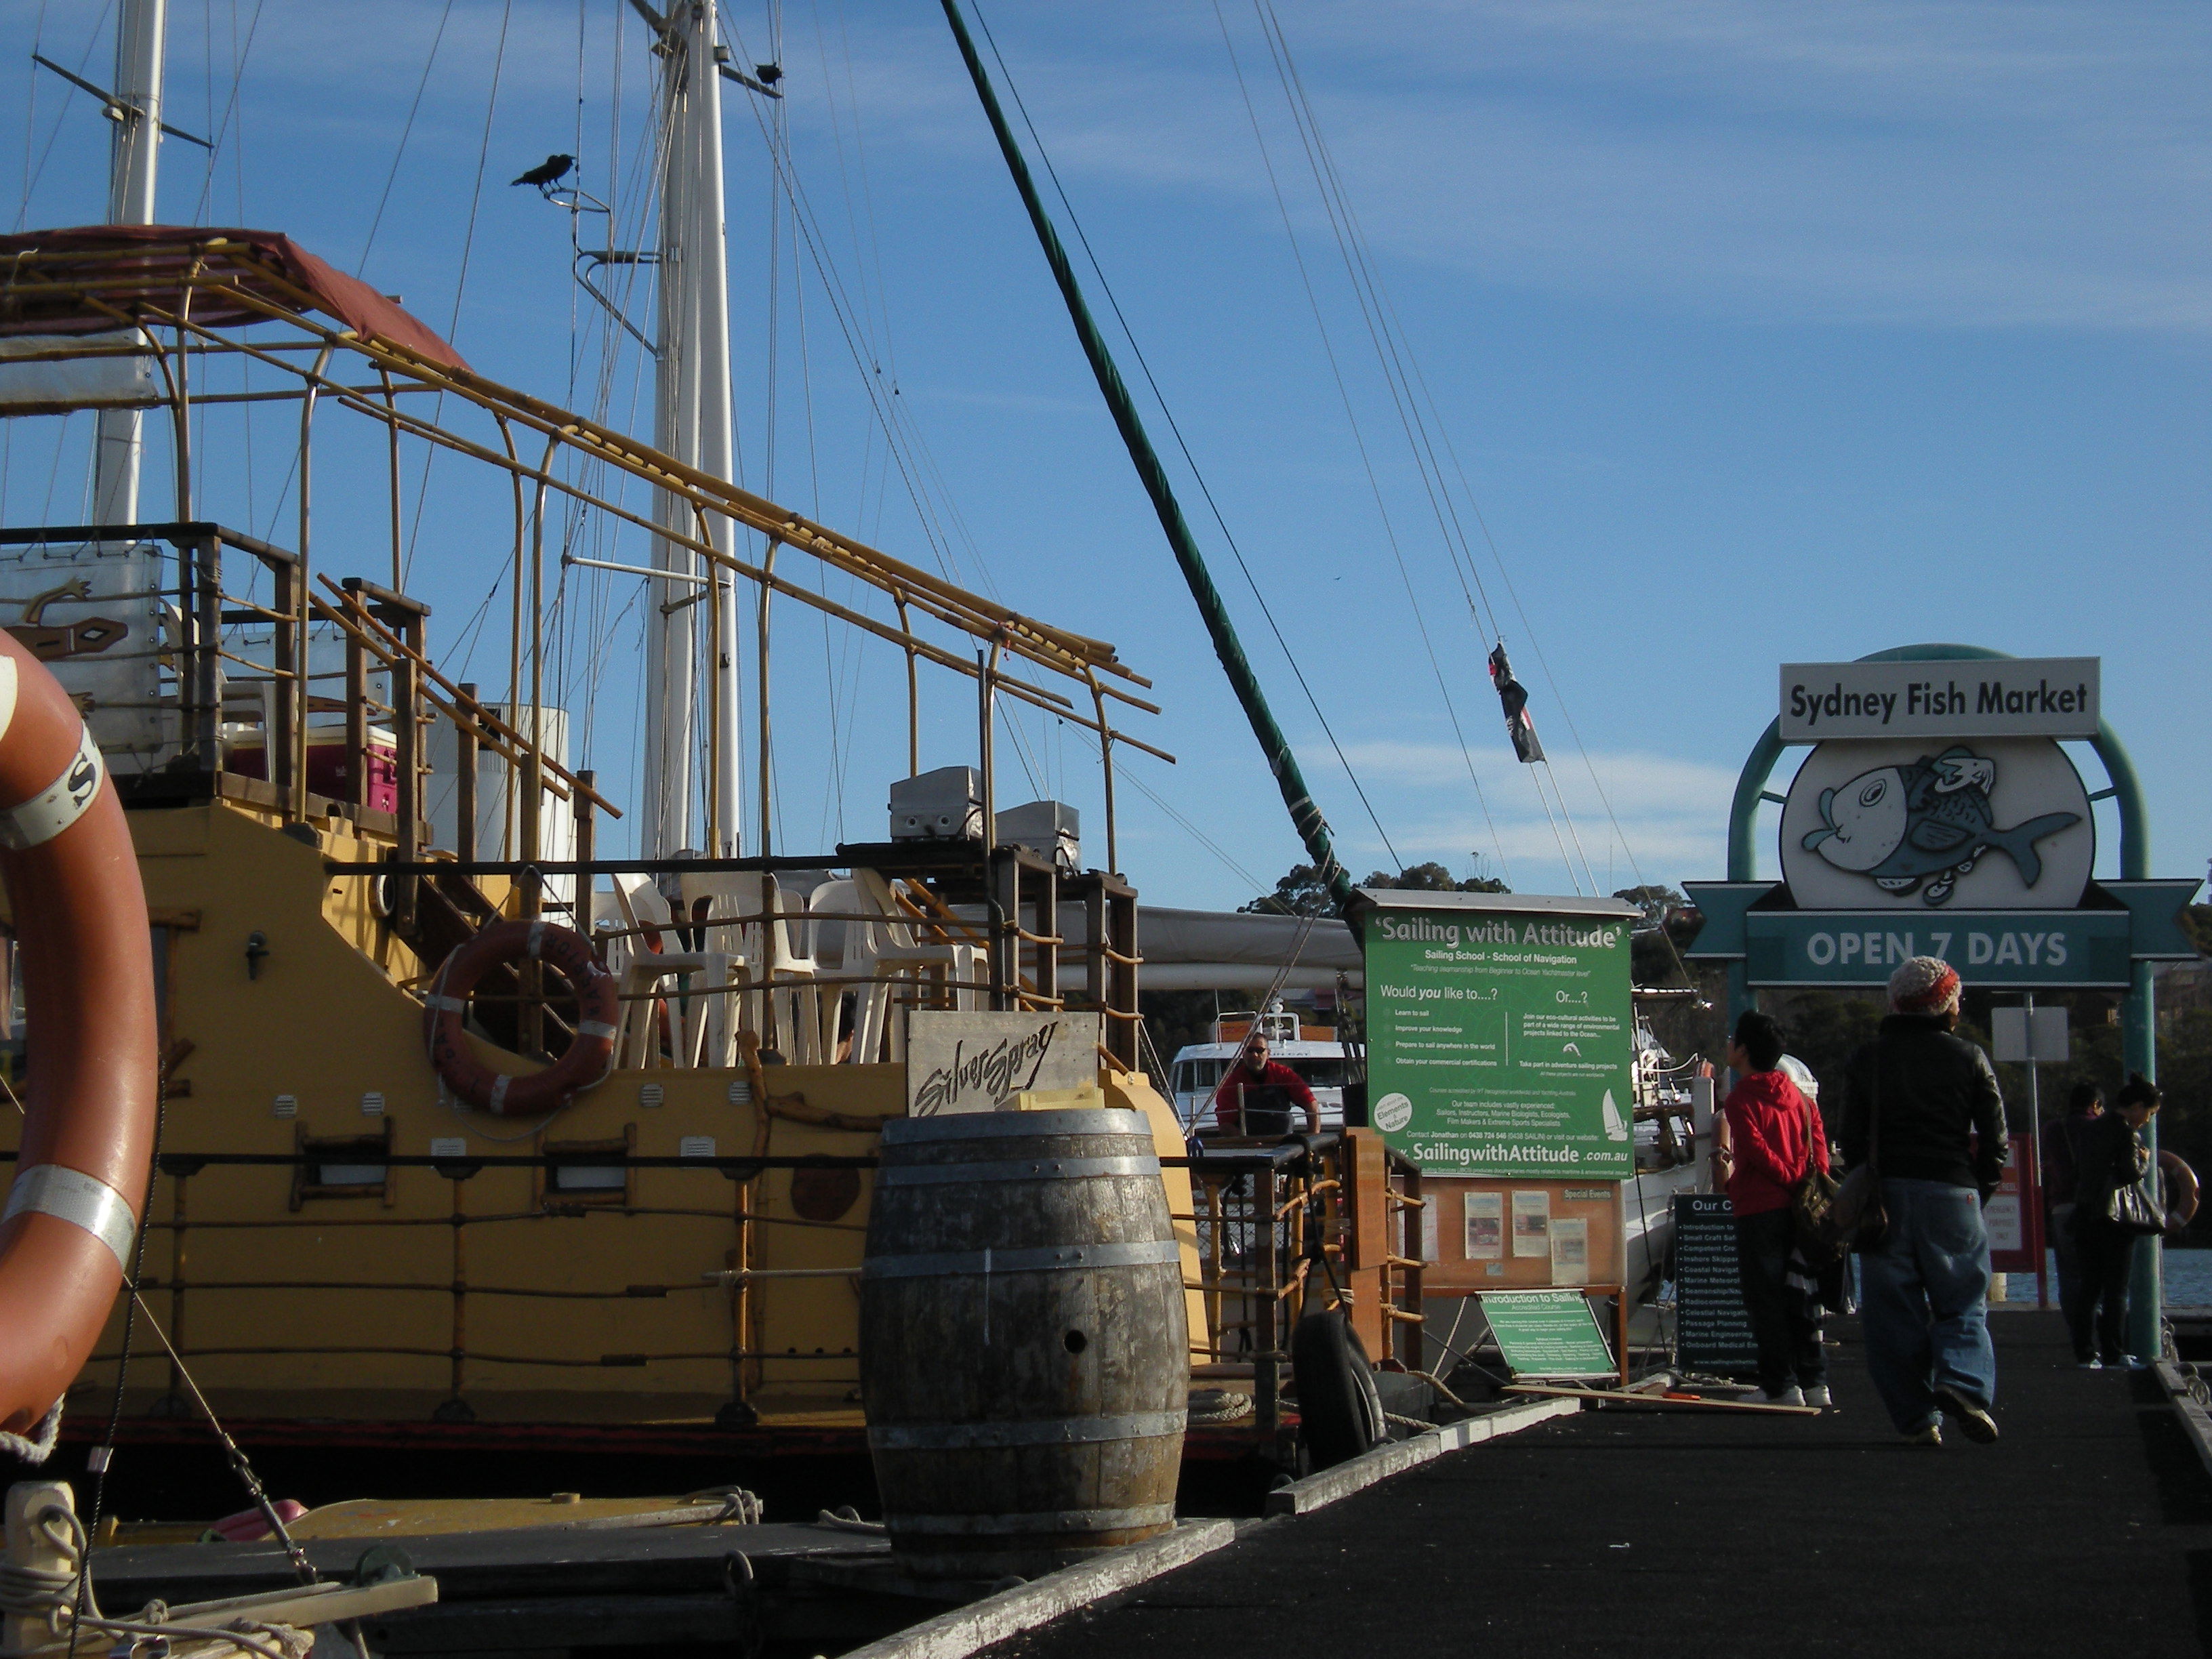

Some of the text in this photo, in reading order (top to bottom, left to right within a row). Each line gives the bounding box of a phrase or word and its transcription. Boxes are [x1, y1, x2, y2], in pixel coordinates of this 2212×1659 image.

[1790, 678, 2088, 724] Sydney Fish Market
[1466, 920, 1517, 943] with
[1807, 932, 2068, 966] OPEN 7 DAYS
[1425, 949, 1454, 961] Sailing
[1456, 951, 1486, 960] School
[1492, 952, 1521, 961] School
[1523, 954, 1532, 962] of
[1534, 954, 1578, 965] Navigation
[1380, 985, 1416, 998] Would
[1418, 989, 1441, 1000] you
[1444, 987, 1464, 999] like
[1432, 1026, 1462, 1034] knowledge
[1395, 1041, 1418, 1049] Prepare
[1377, 1101, 1408, 1120] Elements
[1385, 1115, 1408, 1130] Nature
[1413, 1142, 1579, 1166] SailingwithAttitude
[1583, 1151, 1628, 1161] .com.au
[1564, 1189, 1611, 1200] Special Events
[1692, 1200, 1733, 1211] Our C
[1683, 1245, 1721, 1253] Competent
[1713, 1266, 1739, 1275] Navigat
[1482, 1293, 1584, 1304] Introduction to Sailing
[1685, 1319, 1747, 1328] Passage Planning
[1711, 1331, 1753, 1339] Engineering
